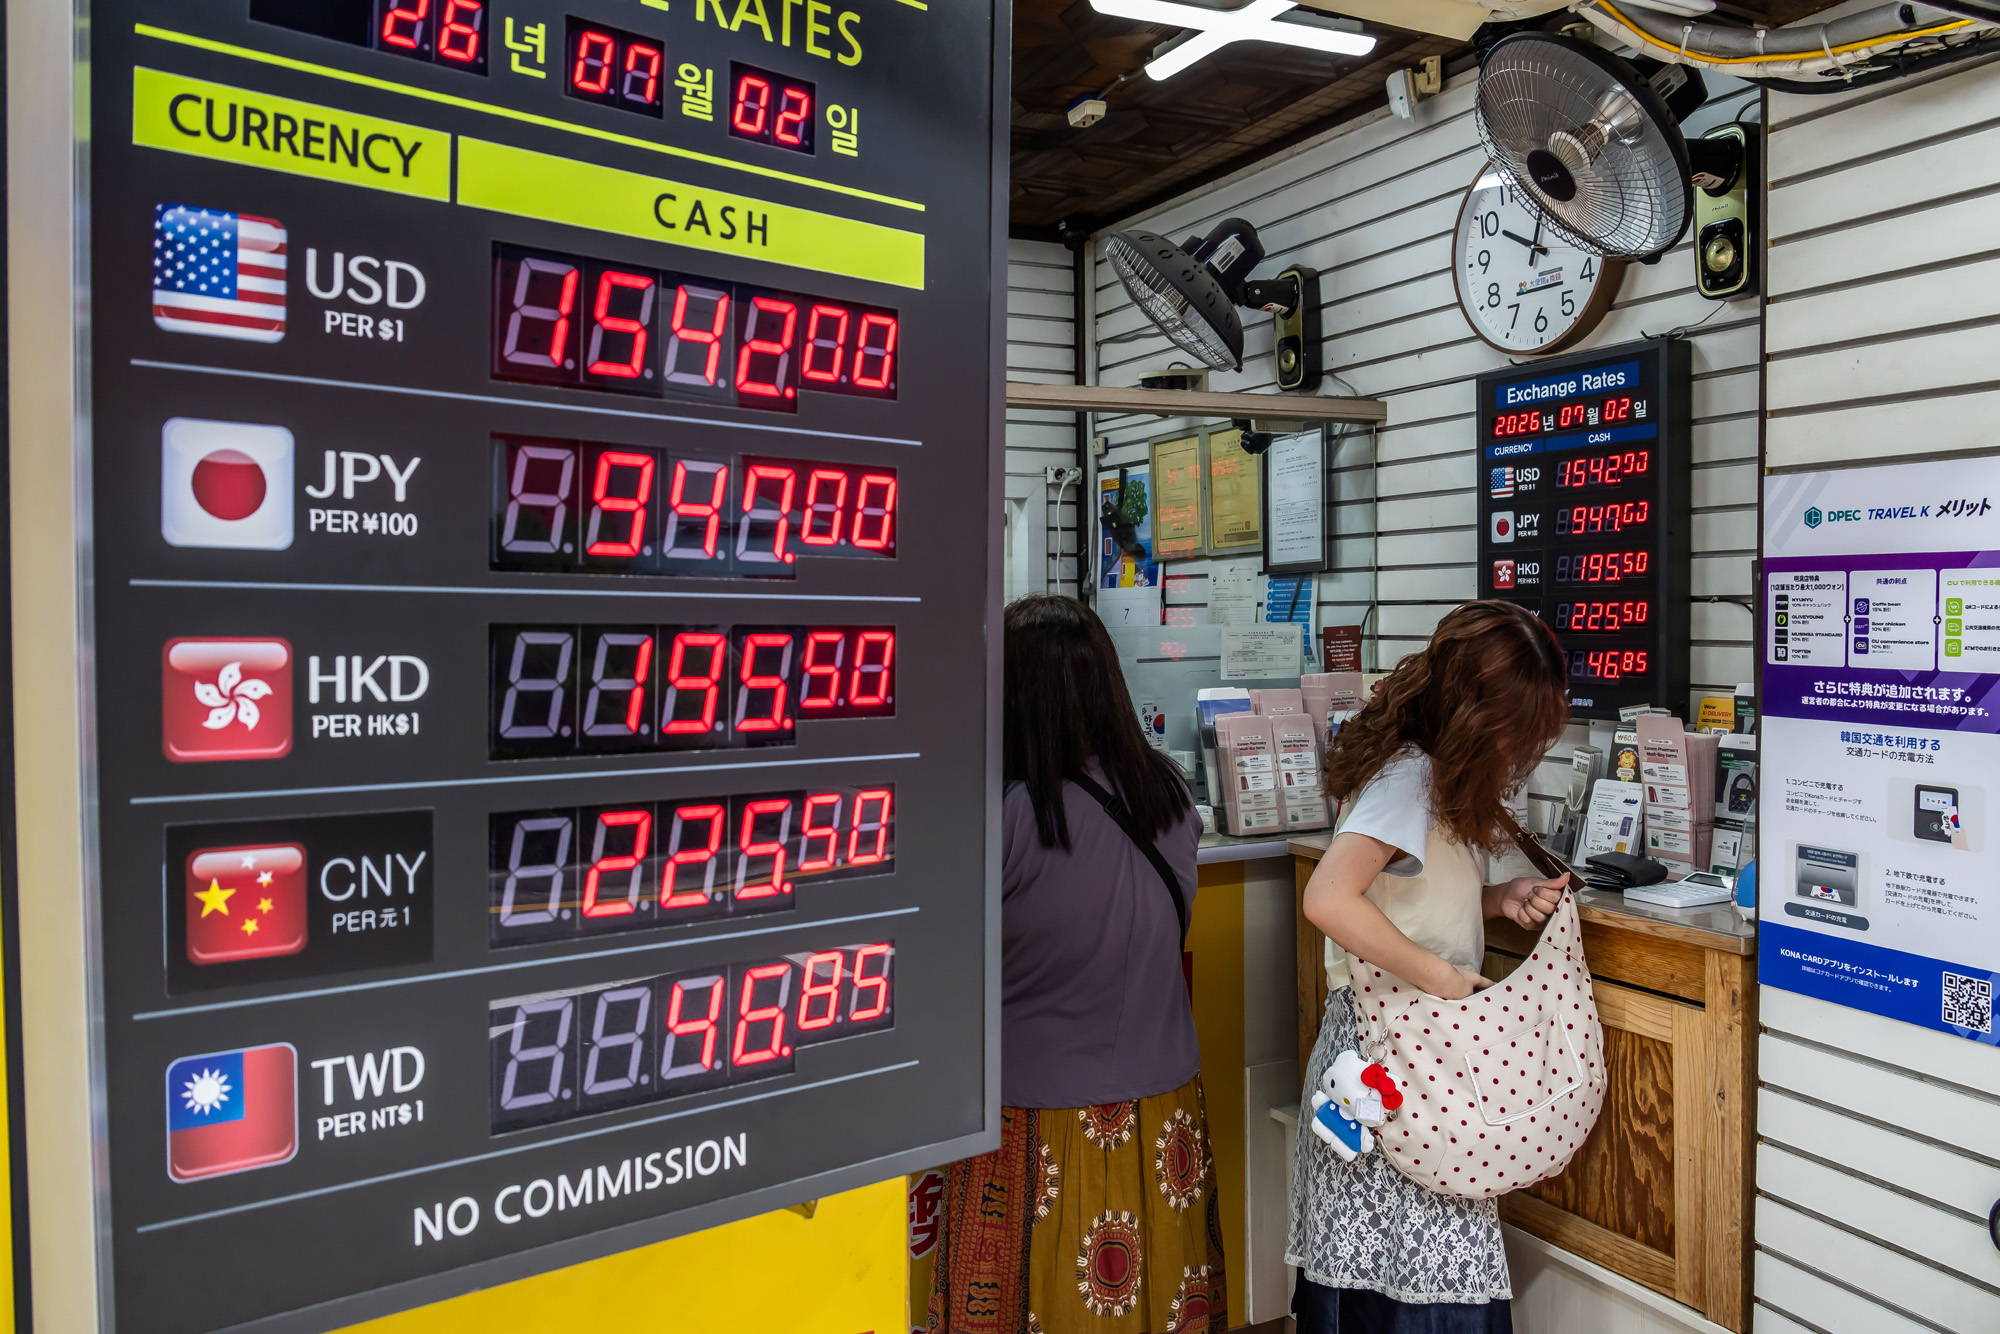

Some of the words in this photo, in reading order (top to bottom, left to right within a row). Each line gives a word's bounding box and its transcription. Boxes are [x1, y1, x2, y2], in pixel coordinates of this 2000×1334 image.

[505, 17, 546, 79] 년
[573, 31, 661, 104] 07
[675, 62, 714, 122] 월
[734, 76, 811, 145] 02
[825, 104, 859, 157] 일
[168, 93, 422, 179] CURRENCY
[653, 193, 769, 247] CASH
[1480, 211, 1500, 239] 10
[1477, 250, 1491, 274] 9
[1579, 257, 1595, 283] 4
[306, 248, 426, 309] USD
[1487, 282, 1501, 308] 8
[1561, 289, 1575, 316] 5
[324, 310, 374, 339] PER
[378, 318, 403, 342] $1
[1507, 303, 1521, 330] 7
[1534, 307, 1548, 332] 6
[1507, 381, 1577, 404] Exchange
[1582, 372, 1625, 391] Rates
[1494, 411, 1540, 436] 2026
[1543, 414, 1554, 431] 년
[1560, 404, 1584, 427] 07
[1587, 407, 1599, 426] 월
[1604, 397, 1630, 420] 02
[1634, 400, 1646, 418] 일
[1494, 443, 1533, 456] CURRENCY
[1588, 432, 1611, 444] CASH
[305, 450, 421, 502] JPY
[1516, 467, 1540, 482] USD
[309, 508, 359, 533] PER
[362, 511, 418, 536] ¥100
[1516, 514, 1540, 529] JPY
[1828, 509, 1861, 522] DPEC
[1868, 506, 1916, 520] TRAVEL
[1920, 505, 1930, 518] K
[1935, 497, 1992, 518] メリット
[1517, 563, 1540, 576] HKD
[1124, 608, 1130, 620] 7
[309, 655, 430, 704] HKD
[1814, 680, 1972, 702] さらに特典が追加されます。
[1801, 696, 1990, 717] 運営者の都合により特典が変更になる場合があります。
[312, 714, 362, 738] PER
[368, 712, 419, 736] HK$1
[1840, 731, 1941, 751] 韓国交通を利用する
[1846, 746, 1935, 764] 交通カードの充電方法
[320, 851, 426, 901] CNY
[1893, 870, 1946, 886] 地下鉄で充電する
[1804, 909, 1848, 924] 交通カードの充電
[1780, 948, 1801, 960] KONA
[1802, 954, 1919, 988] CARDアプリをインストールします
[311, 1046, 425, 1106] TWD
[317, 1111, 366, 1141] PER
[413, 1196, 480, 1246] NO
[494, 1132, 747, 1224] COMMISSION
